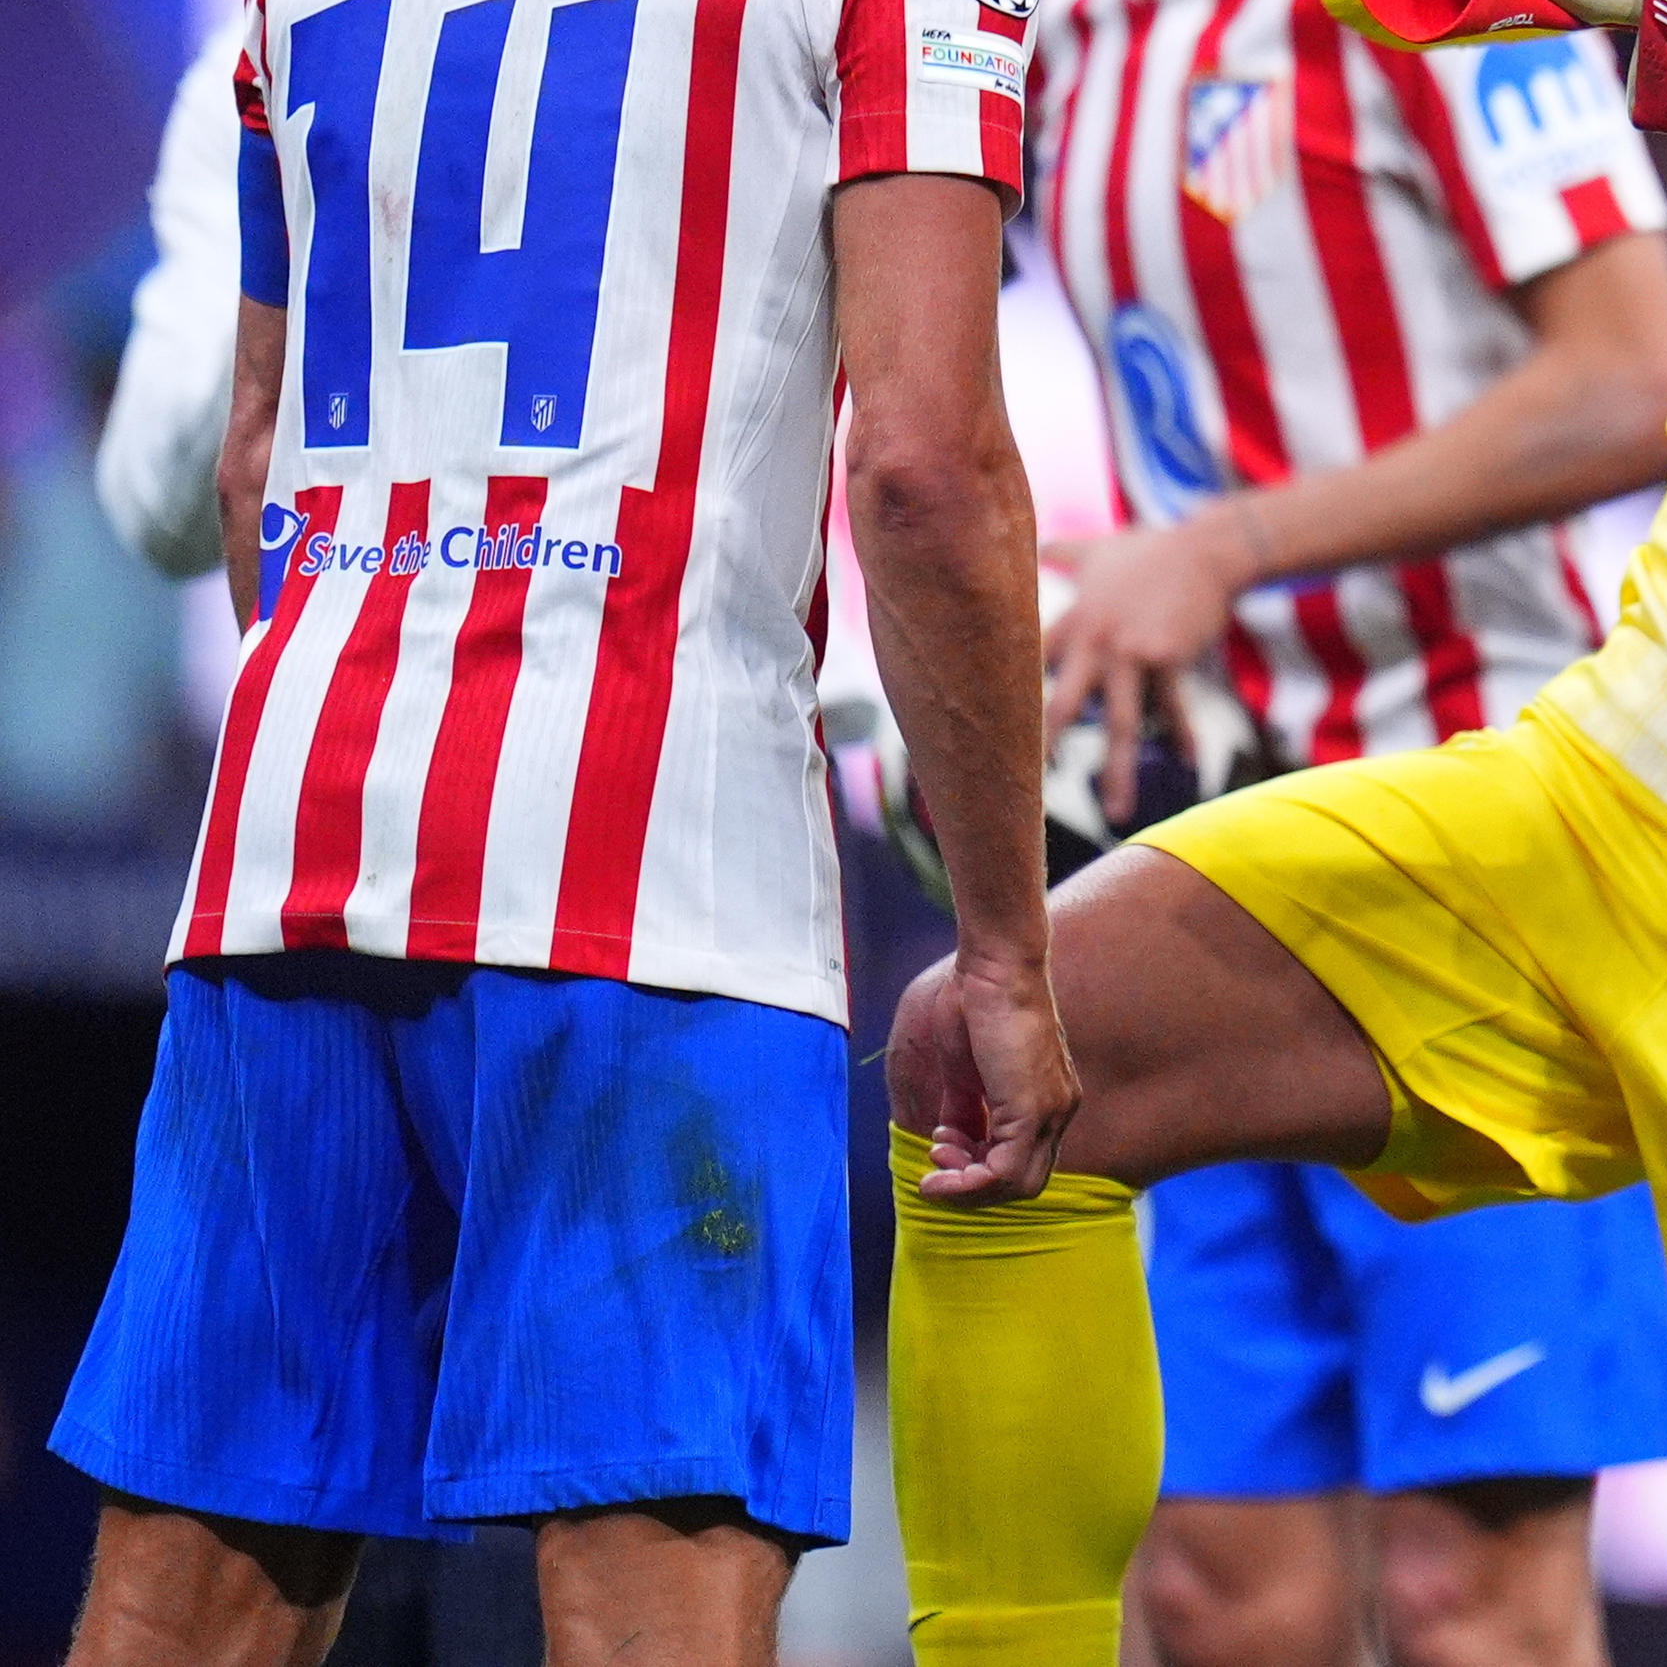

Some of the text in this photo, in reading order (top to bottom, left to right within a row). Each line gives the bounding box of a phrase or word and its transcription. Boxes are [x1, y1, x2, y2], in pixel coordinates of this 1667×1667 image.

[921, 28, 952, 41] UEFA
[300, 524, 622, 577] Save the Children
